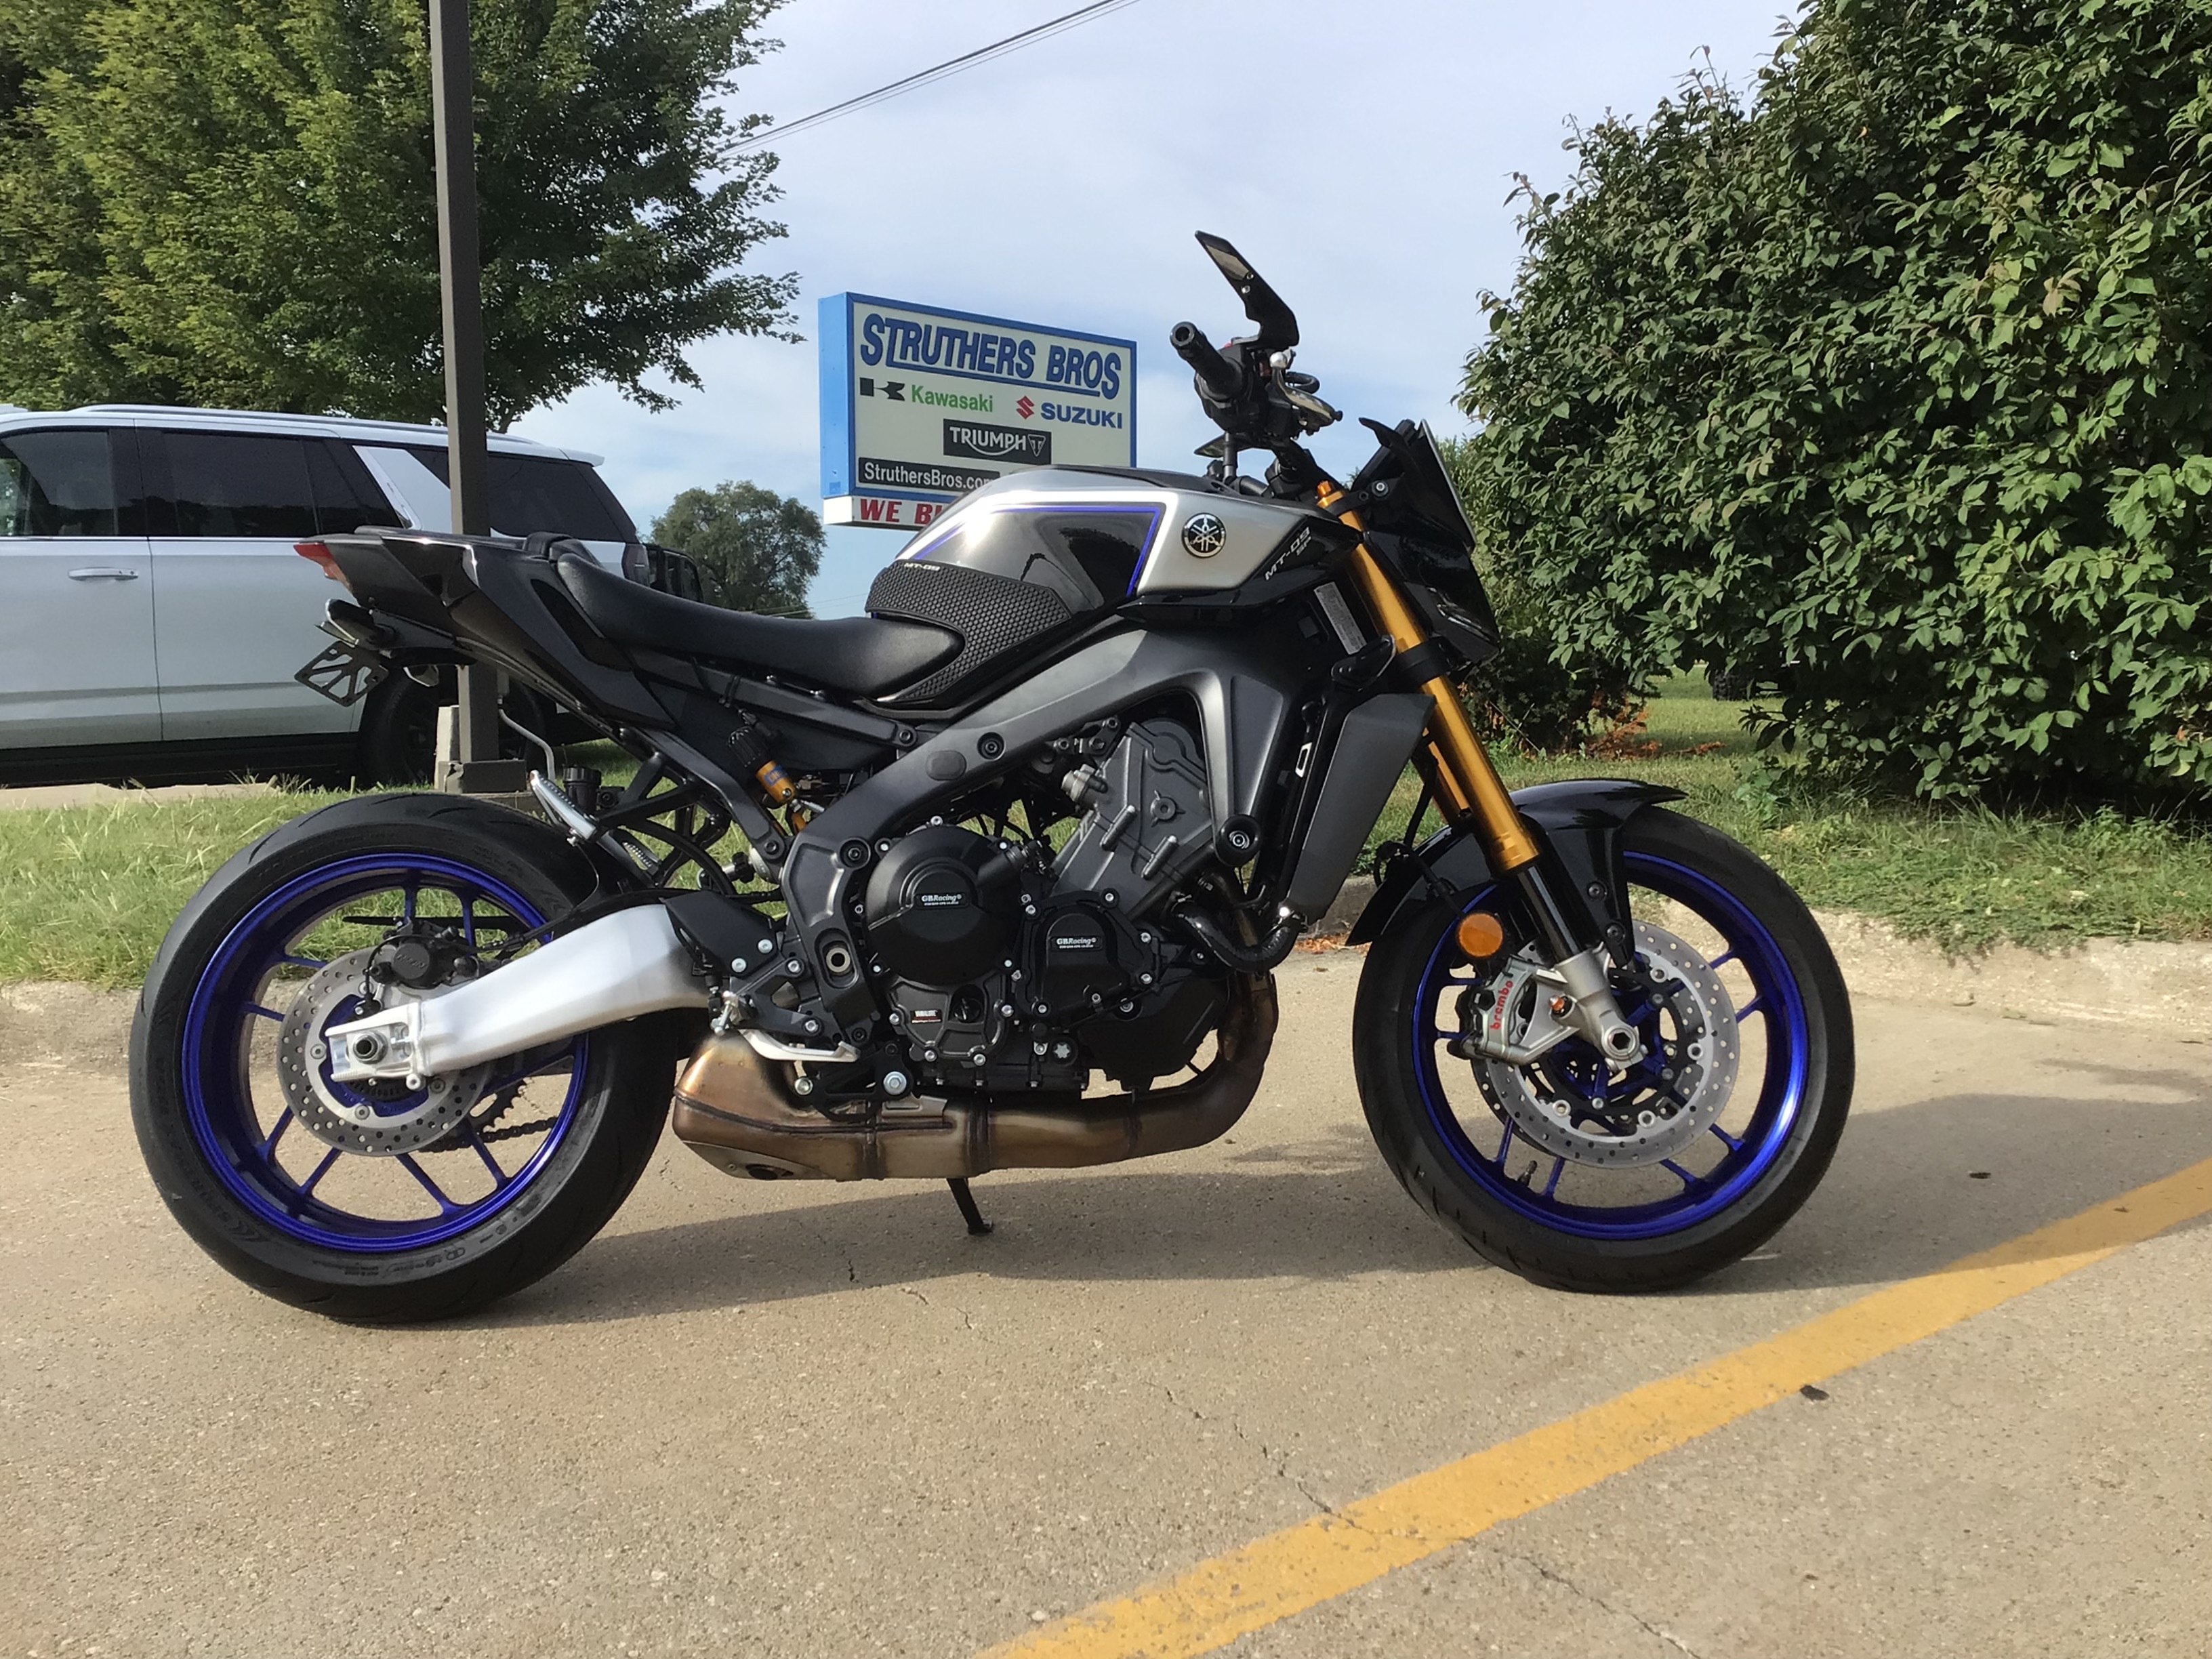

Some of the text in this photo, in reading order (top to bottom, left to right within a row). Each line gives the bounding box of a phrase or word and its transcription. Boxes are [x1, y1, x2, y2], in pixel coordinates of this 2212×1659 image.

[861, 313, 1122, 400] STRUTHERS BROS
[912, 384, 994, 413] Kawasaki
[1041, 402, 1122, 429] SUZUKI
[949, 426, 1027, 455] TRIUMPH
[861, 499, 902, 523] WE
[1265, 527, 1310, 581] MT-09
[1489, 980, 1513, 1029] brembo
